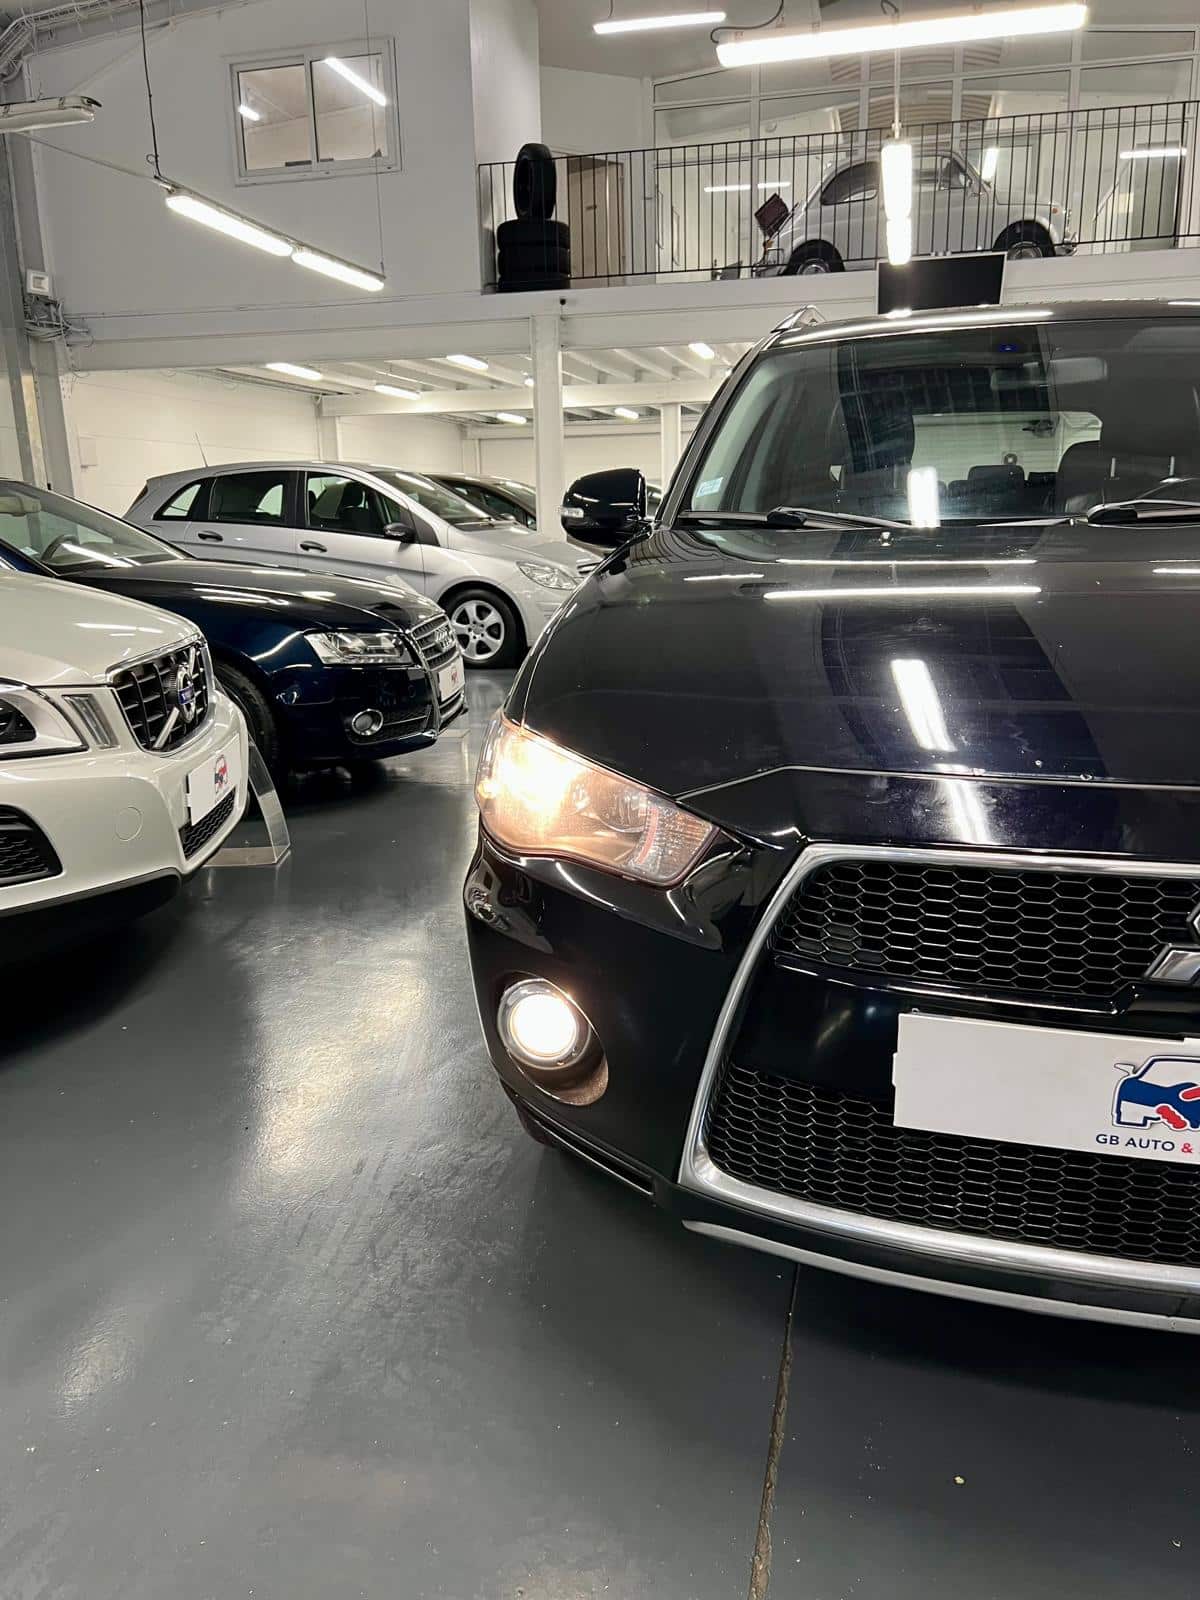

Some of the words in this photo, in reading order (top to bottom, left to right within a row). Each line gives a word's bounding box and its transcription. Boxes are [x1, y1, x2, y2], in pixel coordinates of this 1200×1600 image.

[1095, 1133, 1120, 1145] GB
[1125, 1137, 1175, 1152] AUTO
[1181, 1142, 1193, 1154] &
